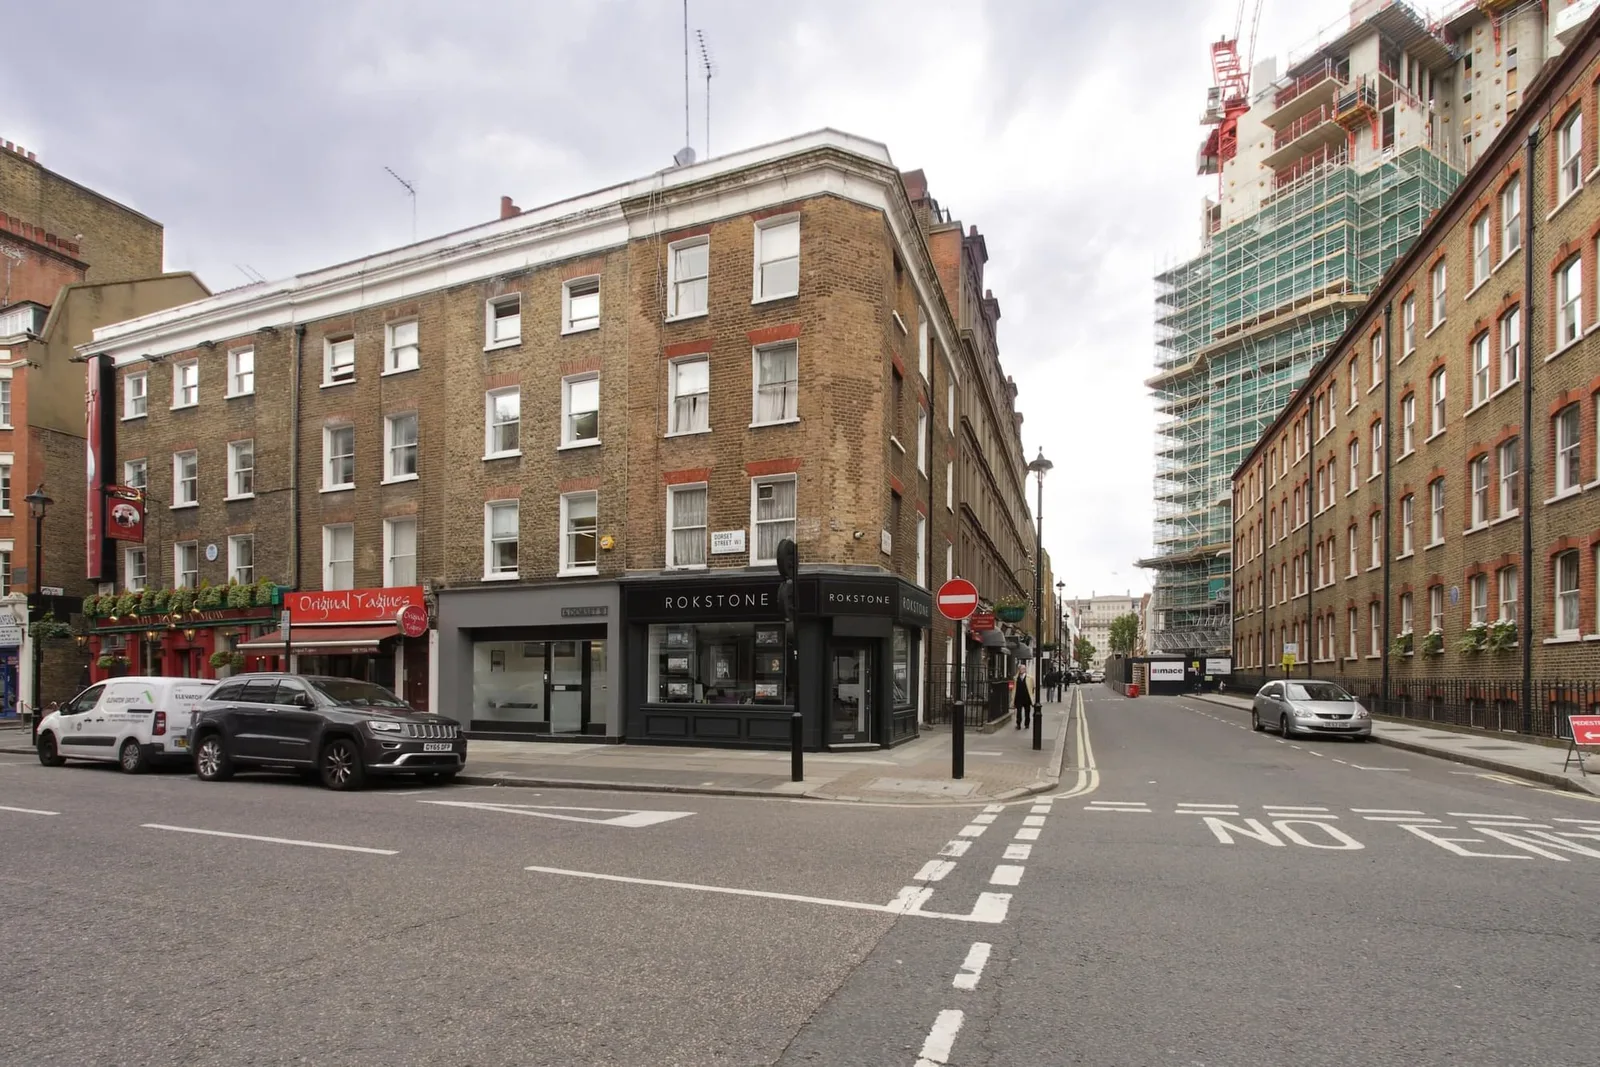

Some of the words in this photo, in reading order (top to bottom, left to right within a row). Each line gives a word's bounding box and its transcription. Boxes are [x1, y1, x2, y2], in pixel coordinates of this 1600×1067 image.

[300, 592, 351, 620] Original
[353, 592, 410, 618] Tagines
[665, 593, 769, 608] ROKSTONE
[829, 593, 890, 604] ROKSTONE
[902, 597, 929, 617] ROKSTONE
[1202, 817, 1366, 850] NO
